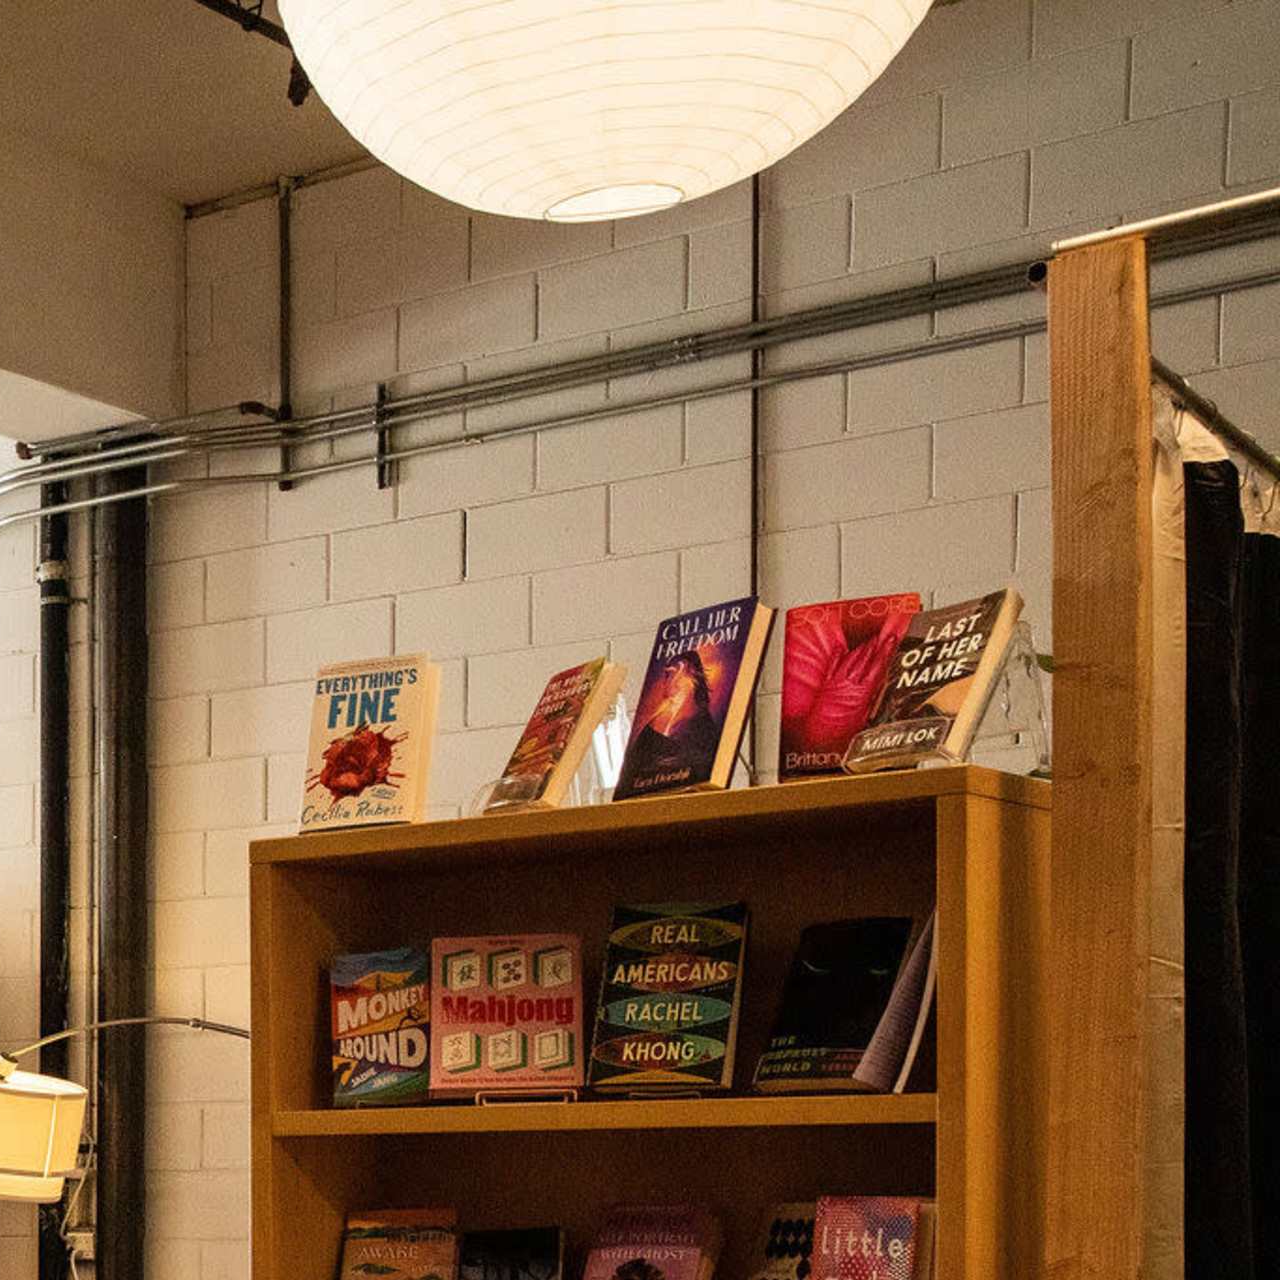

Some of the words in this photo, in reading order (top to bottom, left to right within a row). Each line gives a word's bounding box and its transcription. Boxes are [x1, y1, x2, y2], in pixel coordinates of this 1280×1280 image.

[662, 616, 704, 641] CALL
[707, 606, 741, 630] HER
[924, 613, 982, 644] LAST
[656, 624, 740, 661] FREEDOM
[900, 646, 935, 668] OF
[938, 634, 983, 660] HER
[316, 668, 418, 695] EVERYTHING'S
[896, 657, 969, 689] NAME
[328, 688, 401, 729] FINE
[861, 735, 904, 752] MIMI
[905, 726, 940, 744] LOK
[785, 752, 842, 769] Brittan
[649, 924, 700, 944] REAL
[612, 960, 730, 984] AMERICANS
[337, 984, 425, 1033] MONKEY
[441, 995, 574, 1026] Mahjong
[624, 1001, 704, 1022] RACHEL
[340, 1027, 428, 1068] AROUND
[621, 1041, 695, 1062] KHONG
[821, 1225, 904, 1257] little
